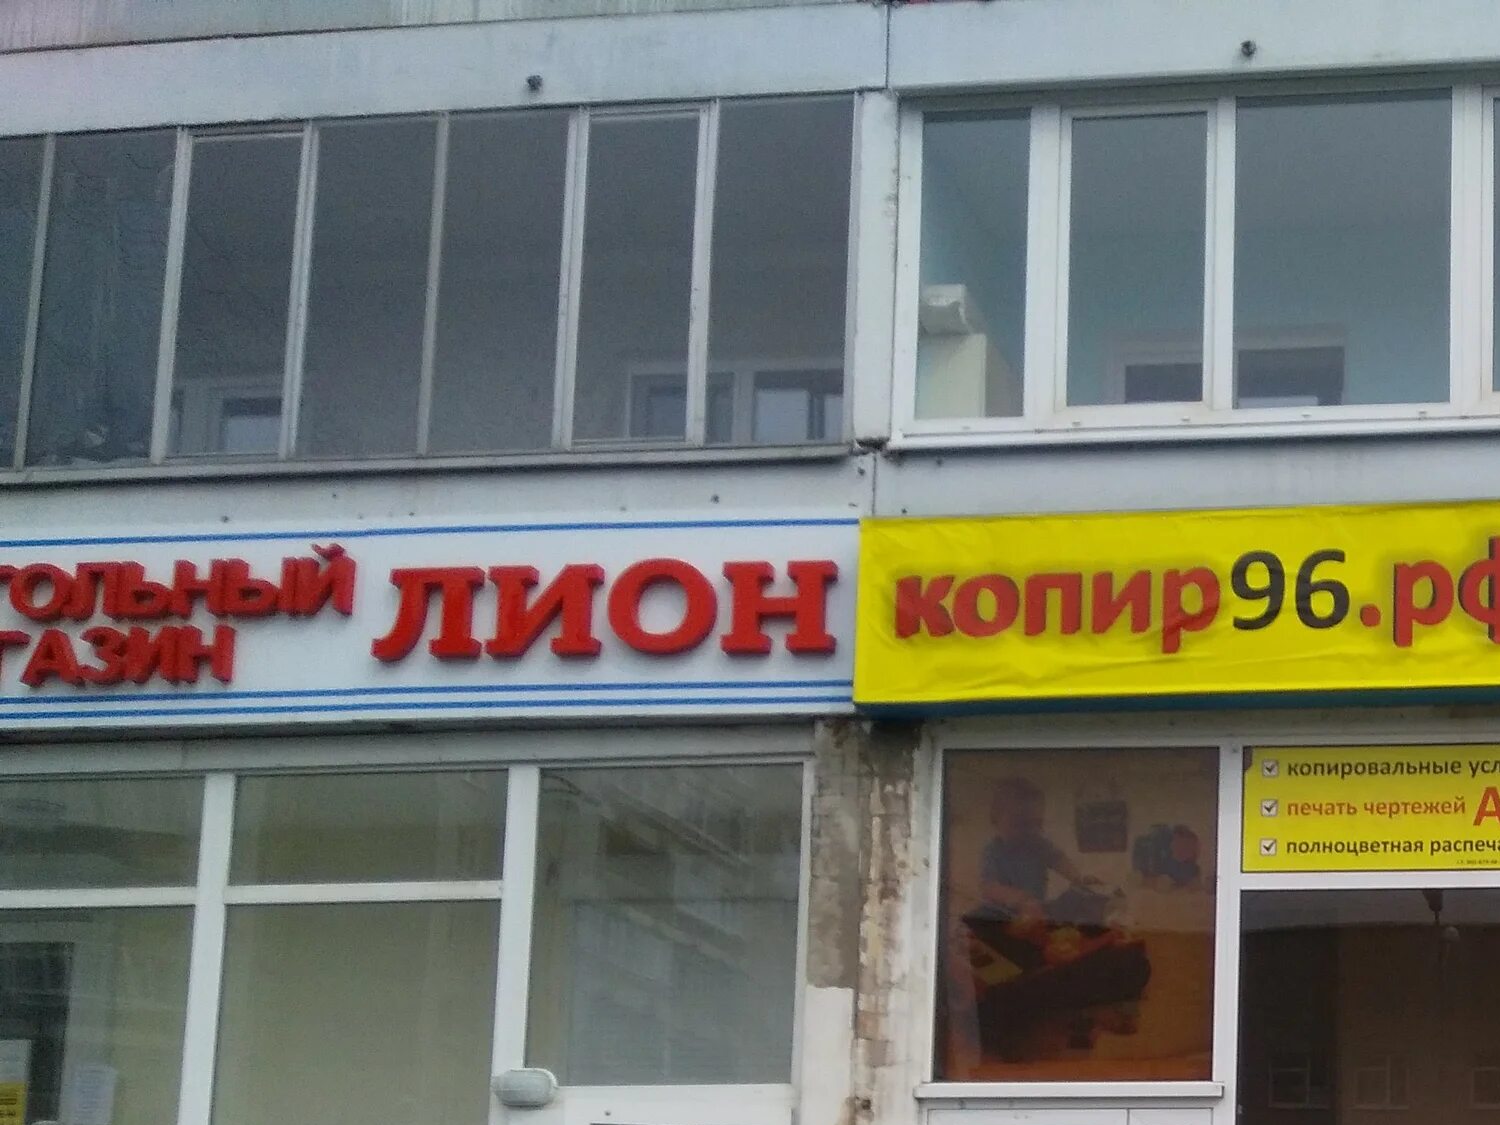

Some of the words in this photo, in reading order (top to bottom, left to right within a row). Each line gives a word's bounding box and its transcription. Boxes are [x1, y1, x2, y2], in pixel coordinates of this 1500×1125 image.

[371, 557, 839, 663] ЛИОН
[1287, 760, 1462, 779] копировальные
[1287, 800, 1358, 817] печать
[1363, 796, 1466, 819] чертежей
[1286, 838, 1424, 857] полноцветная
